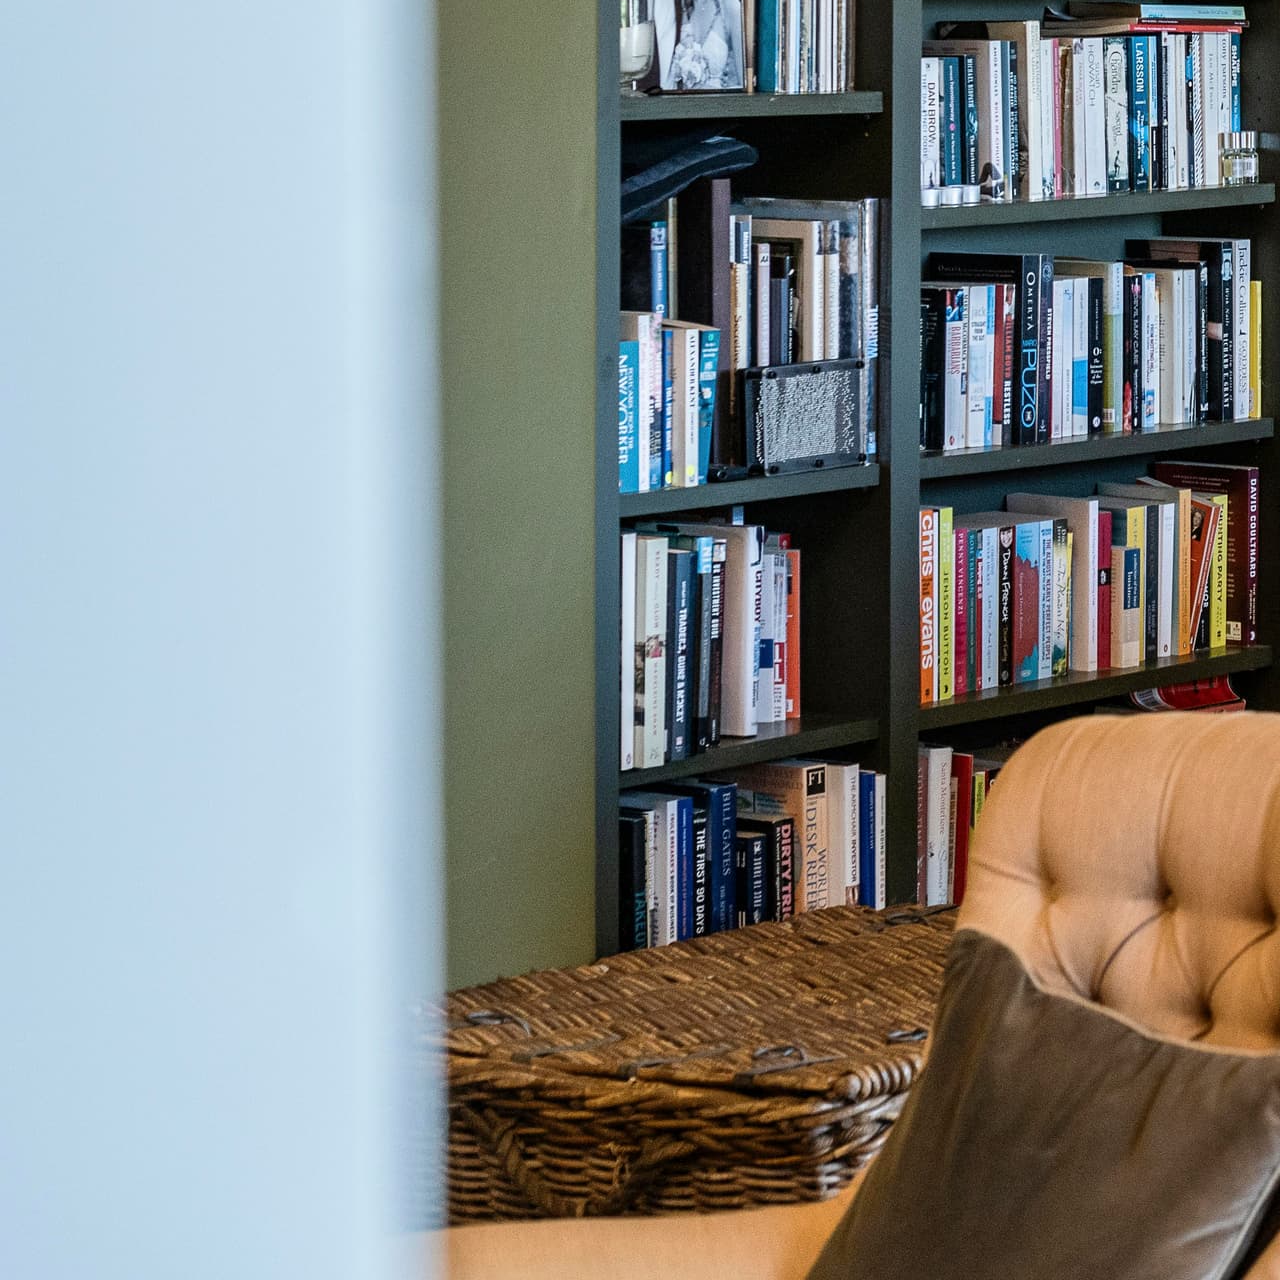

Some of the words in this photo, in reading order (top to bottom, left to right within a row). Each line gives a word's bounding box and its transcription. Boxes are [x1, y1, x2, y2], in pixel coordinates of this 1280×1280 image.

[1088, 44, 1096, 107] HOWATCH
[1110, 51, 1122, 95] Chandra
[1135, 43, 1145, 93] LARSSON
[927, 83, 936, 106] DAN
[1237, 245, 1248, 282] Jackie
[1238, 285, 1248, 325] Collins
[867, 305, 878, 360] WARHOL
[951, 326, 961, 375] BARBARIANS
[618, 355, 628, 391] NEW
[1021, 348, 1037, 429] PUZO
[1003, 381, 1011, 425] RESTLESS
[618, 393, 628, 465] YORKER
[922, 515, 933, 577] chris
[754, 571, 762, 623] CITYBOY
[922, 597, 933, 671] evans
[807, 771, 825, 787] FT
[940, 762, 948, 786] Santa
[722, 792, 731, 826] BILL
[806, 808, 817, 856] DESK
[939, 787, 947, 836] Montefiore
[696, 829, 705, 852] THE
[722, 829, 731, 877] GATES
[781, 824, 792, 881] DIRTY
[696, 854, 705, 885] FIRST
[816, 848, 827, 908] WORLD
[696, 887, 705, 903] 90
[696, 906, 705, 935] DAYS
